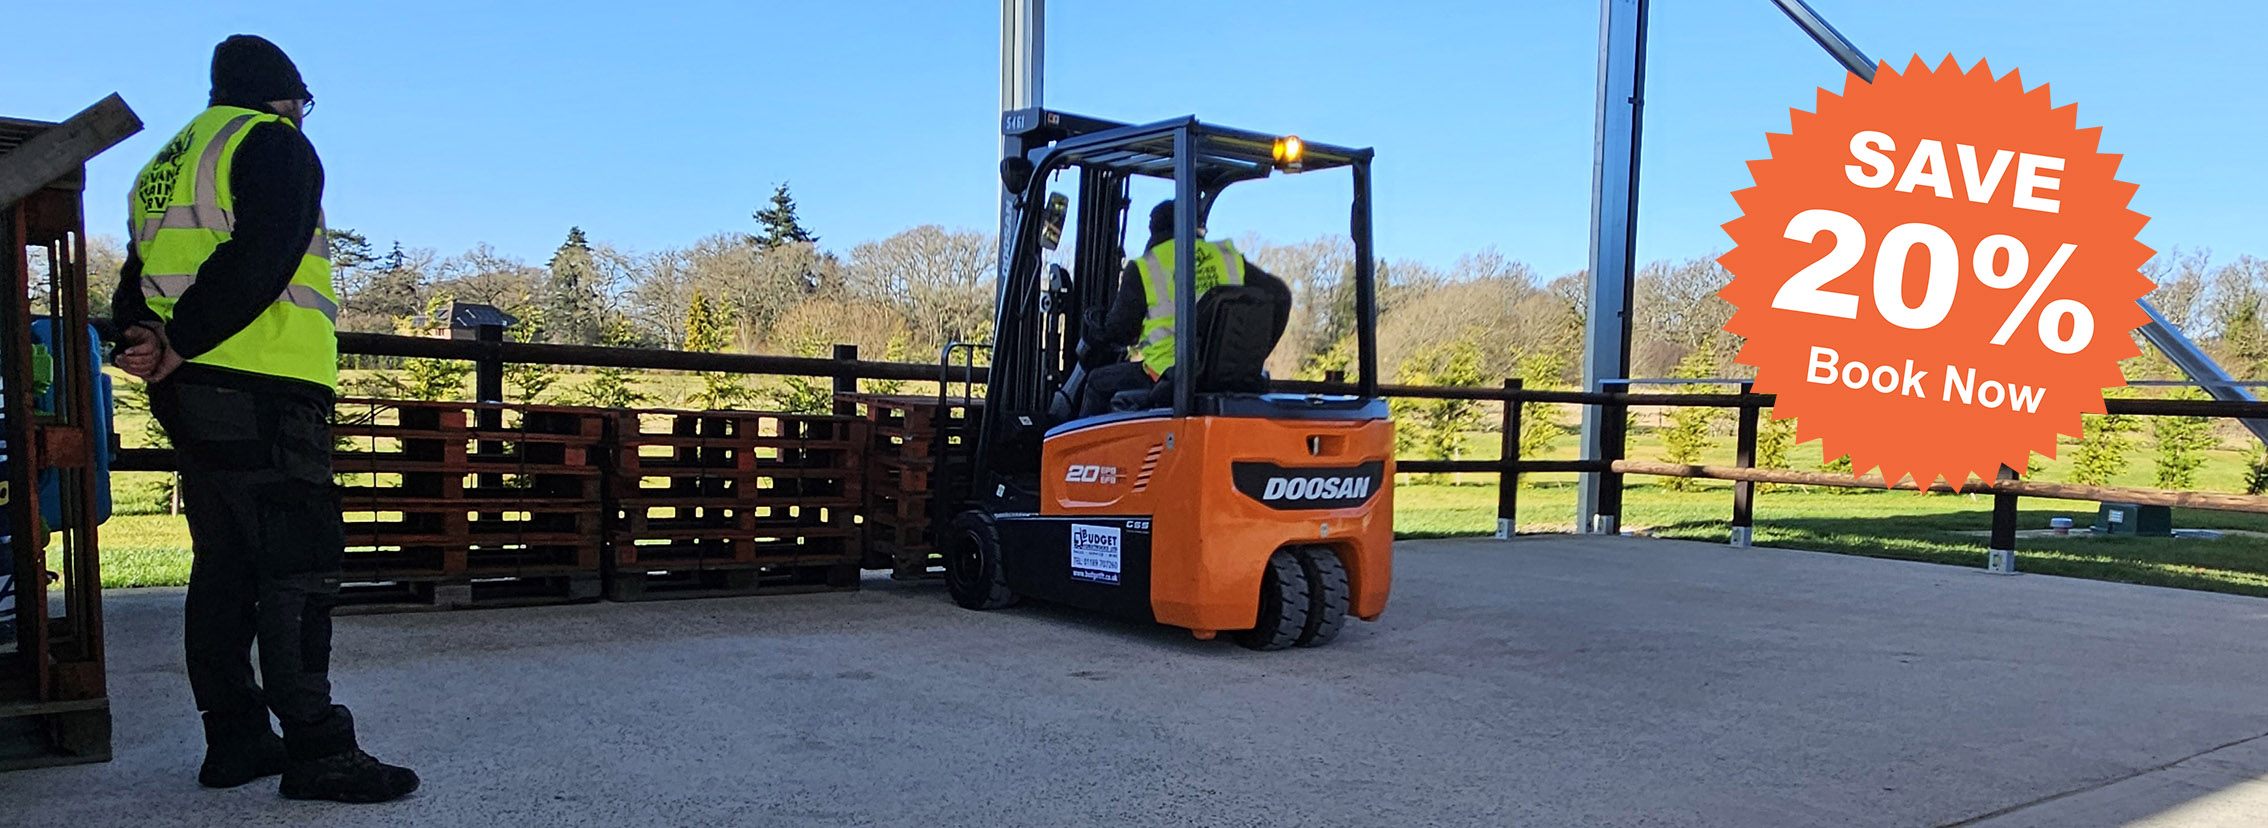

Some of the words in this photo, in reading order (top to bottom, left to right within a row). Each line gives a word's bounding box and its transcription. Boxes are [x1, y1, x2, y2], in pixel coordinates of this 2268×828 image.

[1065, 465, 1100, 482] 20
[1263, 476, 1370, 500] DOOSAN
[1081, 529, 1117, 546] BUDGET
